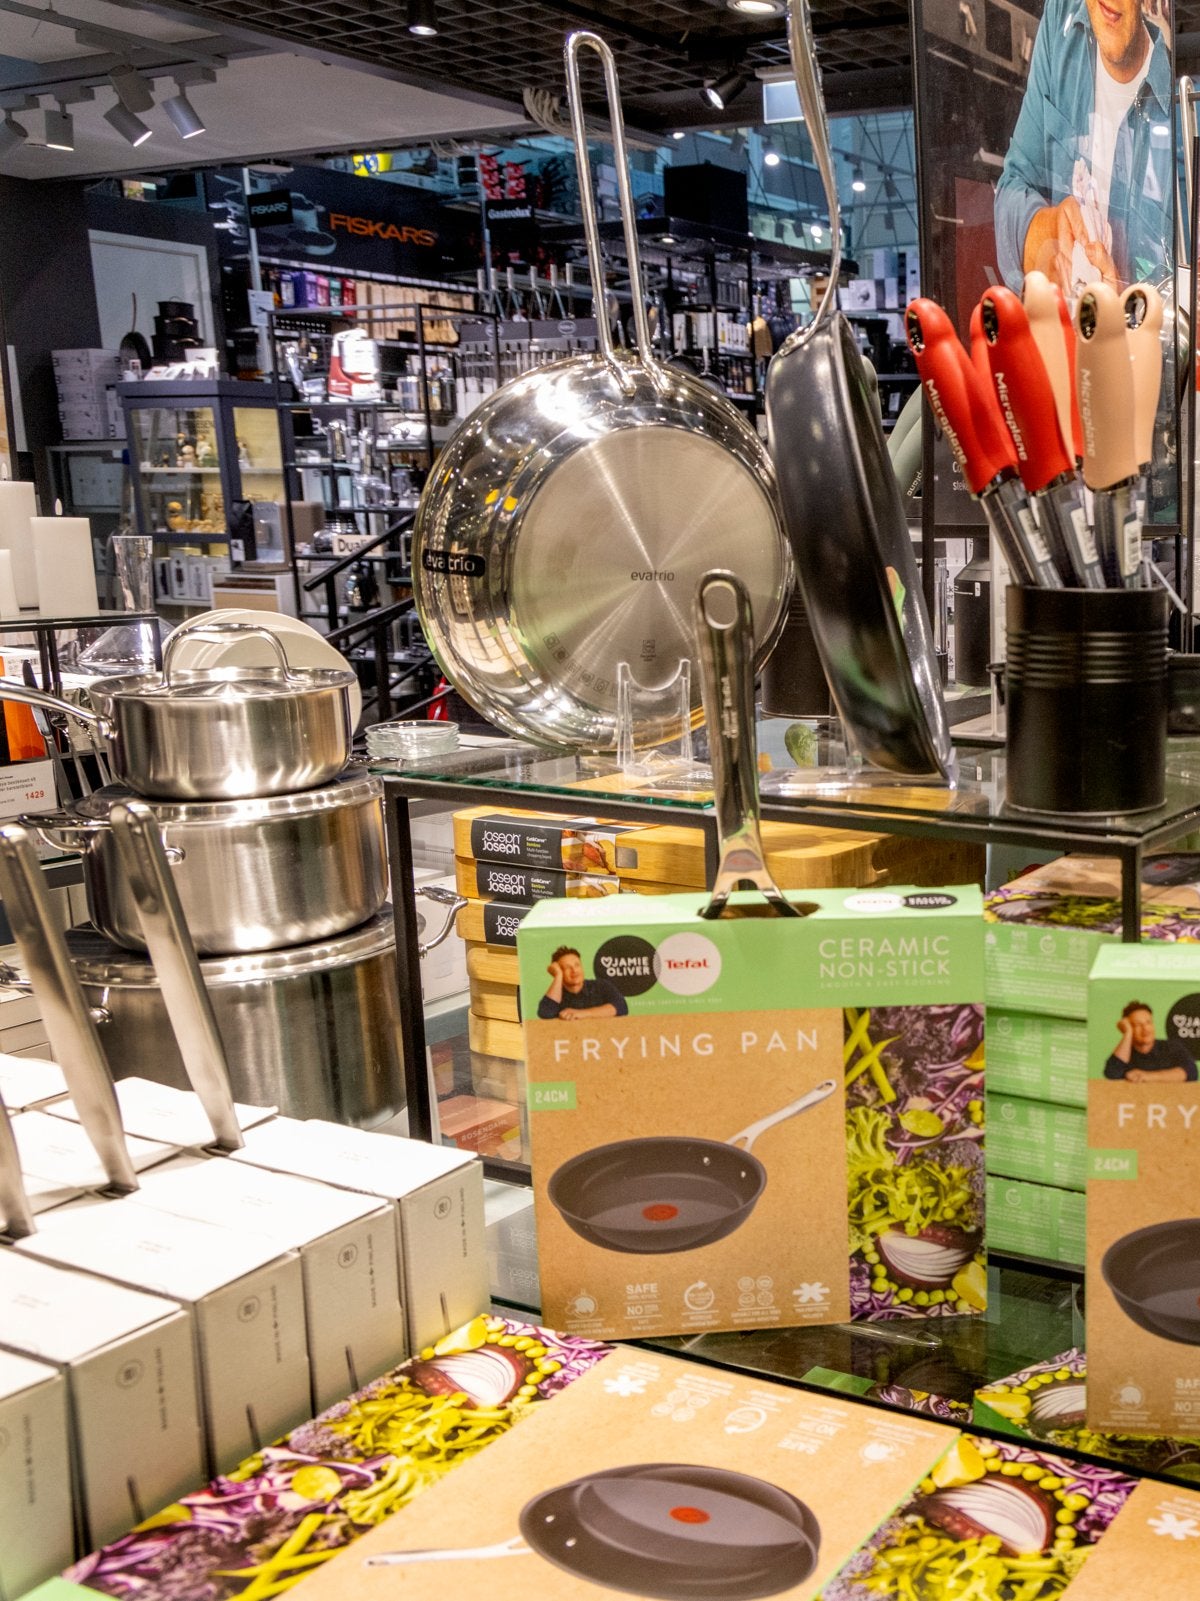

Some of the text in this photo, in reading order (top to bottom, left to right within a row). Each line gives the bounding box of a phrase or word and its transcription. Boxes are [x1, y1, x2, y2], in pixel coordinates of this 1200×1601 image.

[328, 211, 437, 247] FISKARS
[995, 372, 1028, 461] Microplane
[1080, 368, 1096, 458] Microplane
[926, 378, 968, 465] Microplane
[25, 790, 45, 799] 1429
[482, 829, 521, 846] Joseph
[482, 840, 521, 855] Joseph
[487, 871, 526, 886] Joseph
[488, 881, 526, 896] Joseph
[818, 935, 950, 960] CERAMIC
[611, 955, 650, 969] JAMIE
[664, 957, 710, 971] Tefal
[819, 958, 951, 980] NON-STICK
[606, 965, 651, 978] OLIVER
[553, 1028, 820, 1063] FRYING PAN
[534, 1091, 569, 1104] 24CM
[1093, 1157, 1132, 1173] 24CM
[626, 1283, 658, 1295] SAFE
[626, 1305, 644, 1316] NO
[1175, 1401, 1192, 1413] NO
